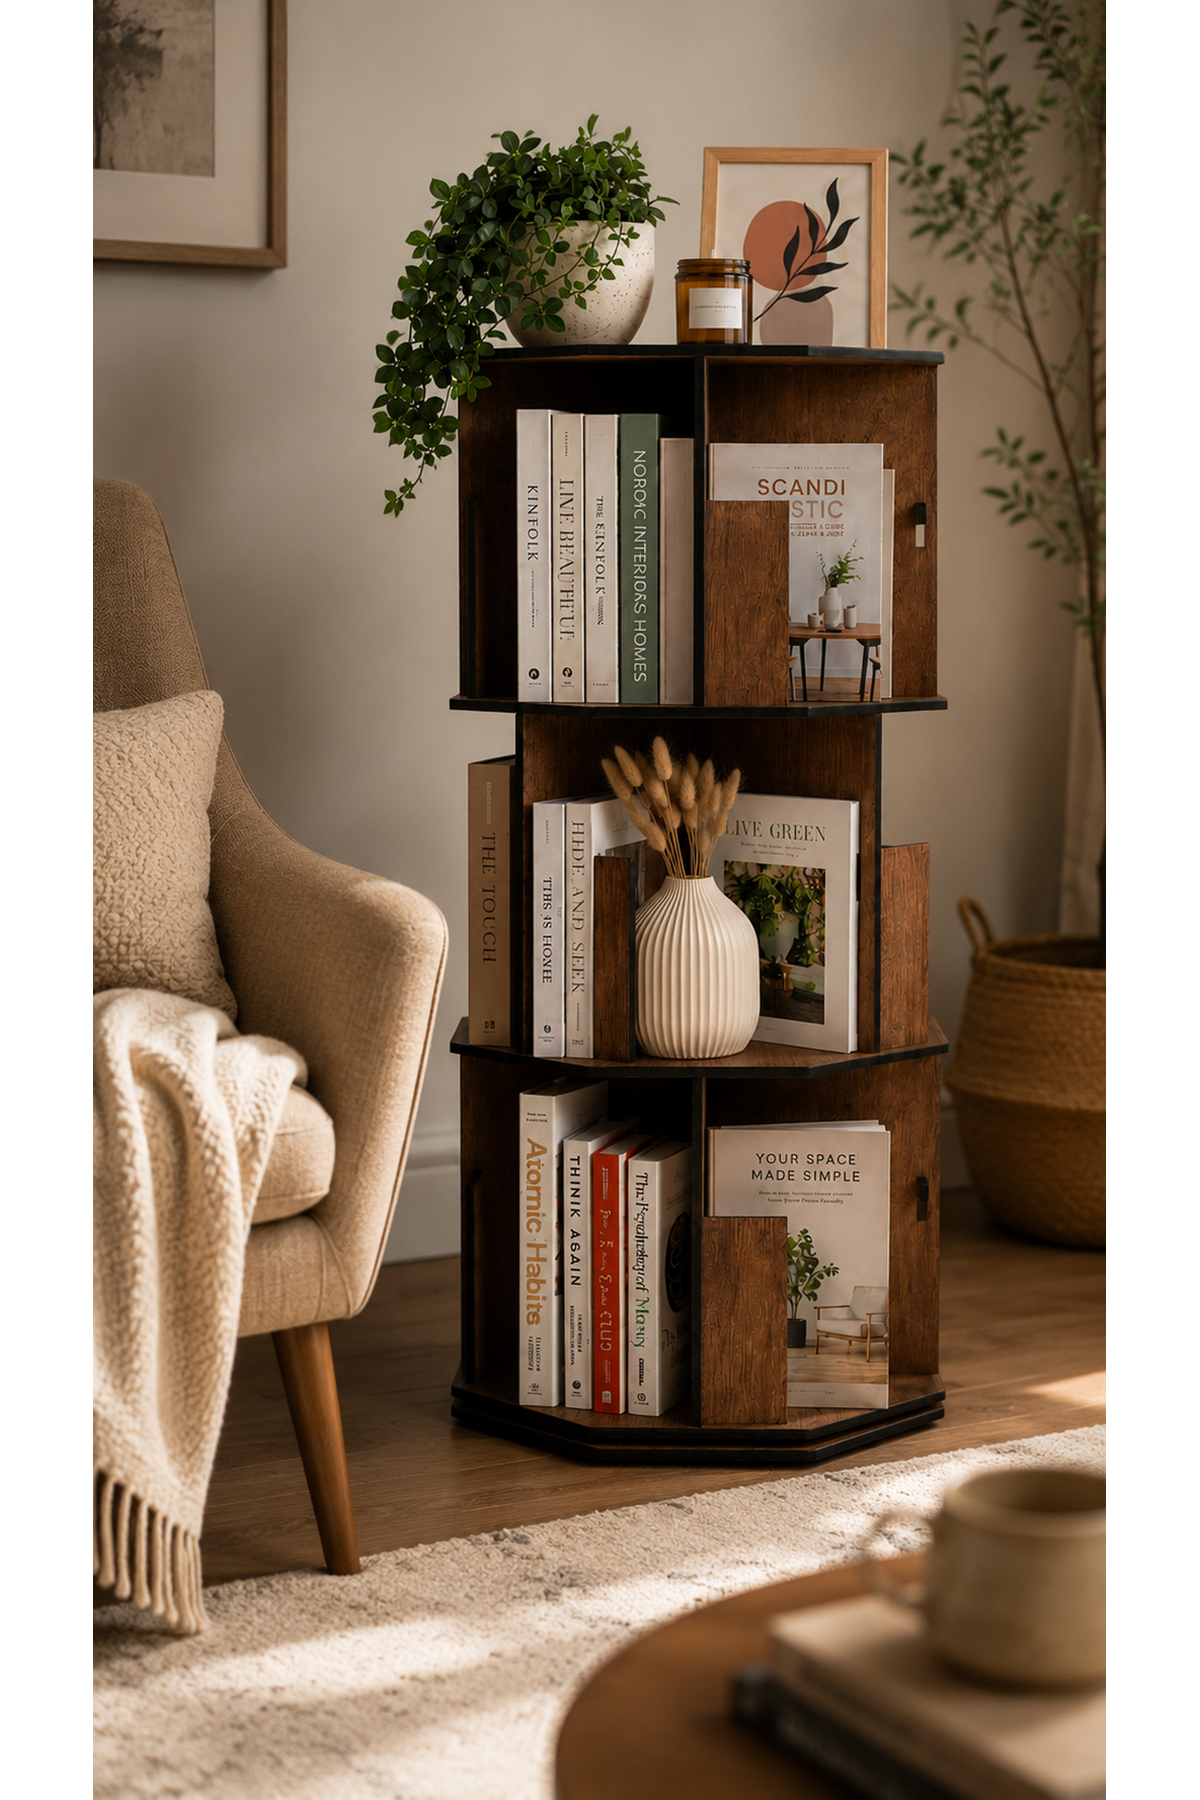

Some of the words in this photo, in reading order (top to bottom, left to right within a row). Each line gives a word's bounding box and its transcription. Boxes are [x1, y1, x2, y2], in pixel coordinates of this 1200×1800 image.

[757, 478, 846, 496] SCANDI
[791, 500, 844, 519] STIC
[527, 485, 539, 561] KINFOLK
[633, 620, 647, 682] HOMES
[482, 832, 496, 875] THE
[725, 819, 763, 838] LIVE
[769, 822, 827, 842] GREEN
[482, 885, 497, 964] TOUCH
[571, 941, 585, 994] SEEK
[751, 1169, 796, 1181] MADE
[803, 1170, 861, 1182] SIMPLE
[755, 1153, 799, 1165] YOUR
[806, 1153, 857, 1165] SPACE
[526, 1137, 549, 1234] Atomic
[526, 1243, 548, 1327] Habits
